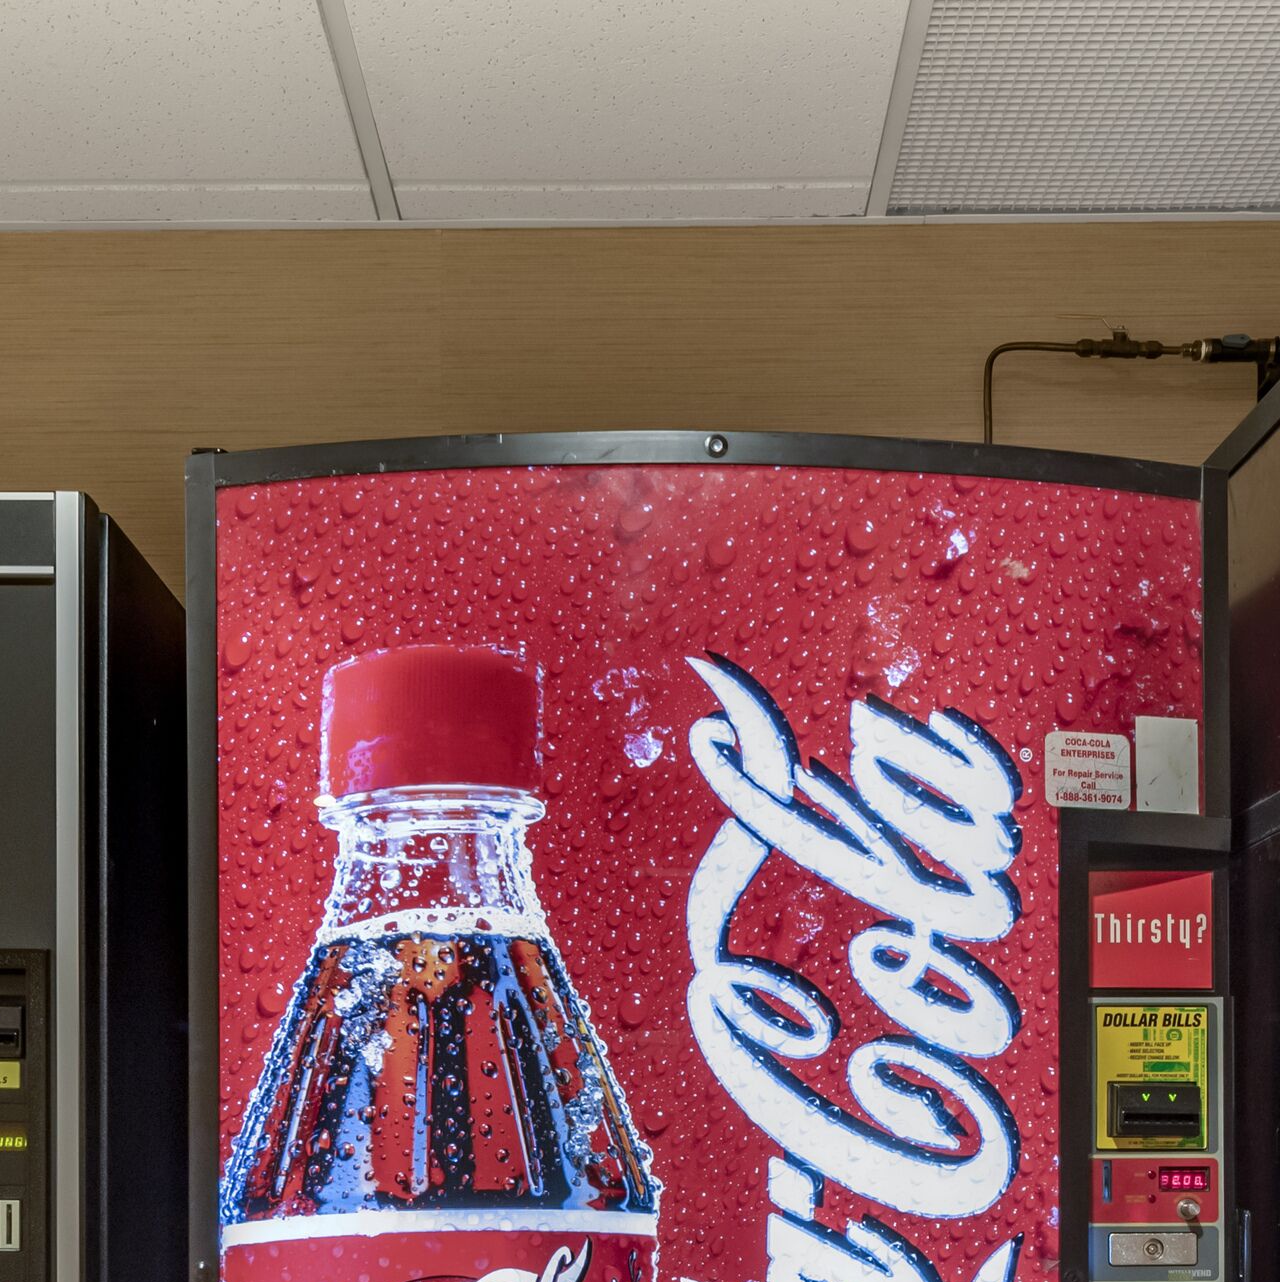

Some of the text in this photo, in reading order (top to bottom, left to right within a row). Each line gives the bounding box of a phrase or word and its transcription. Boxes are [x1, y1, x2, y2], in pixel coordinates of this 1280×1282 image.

[1065, 738, 1111, 748] COCA-COLA
[1060, 749, 1116, 760] ENTERPRISES
[1052, 768, 1124, 780] For Repair Service
[1081, 781, 1096, 790] Call
[1055, 792, 1123, 804] 1-888-361-9074
[1094, 913, 1207, 949] Thirsty?
[1103, 1013, 1202, 1028] DOLLAR BILLS
